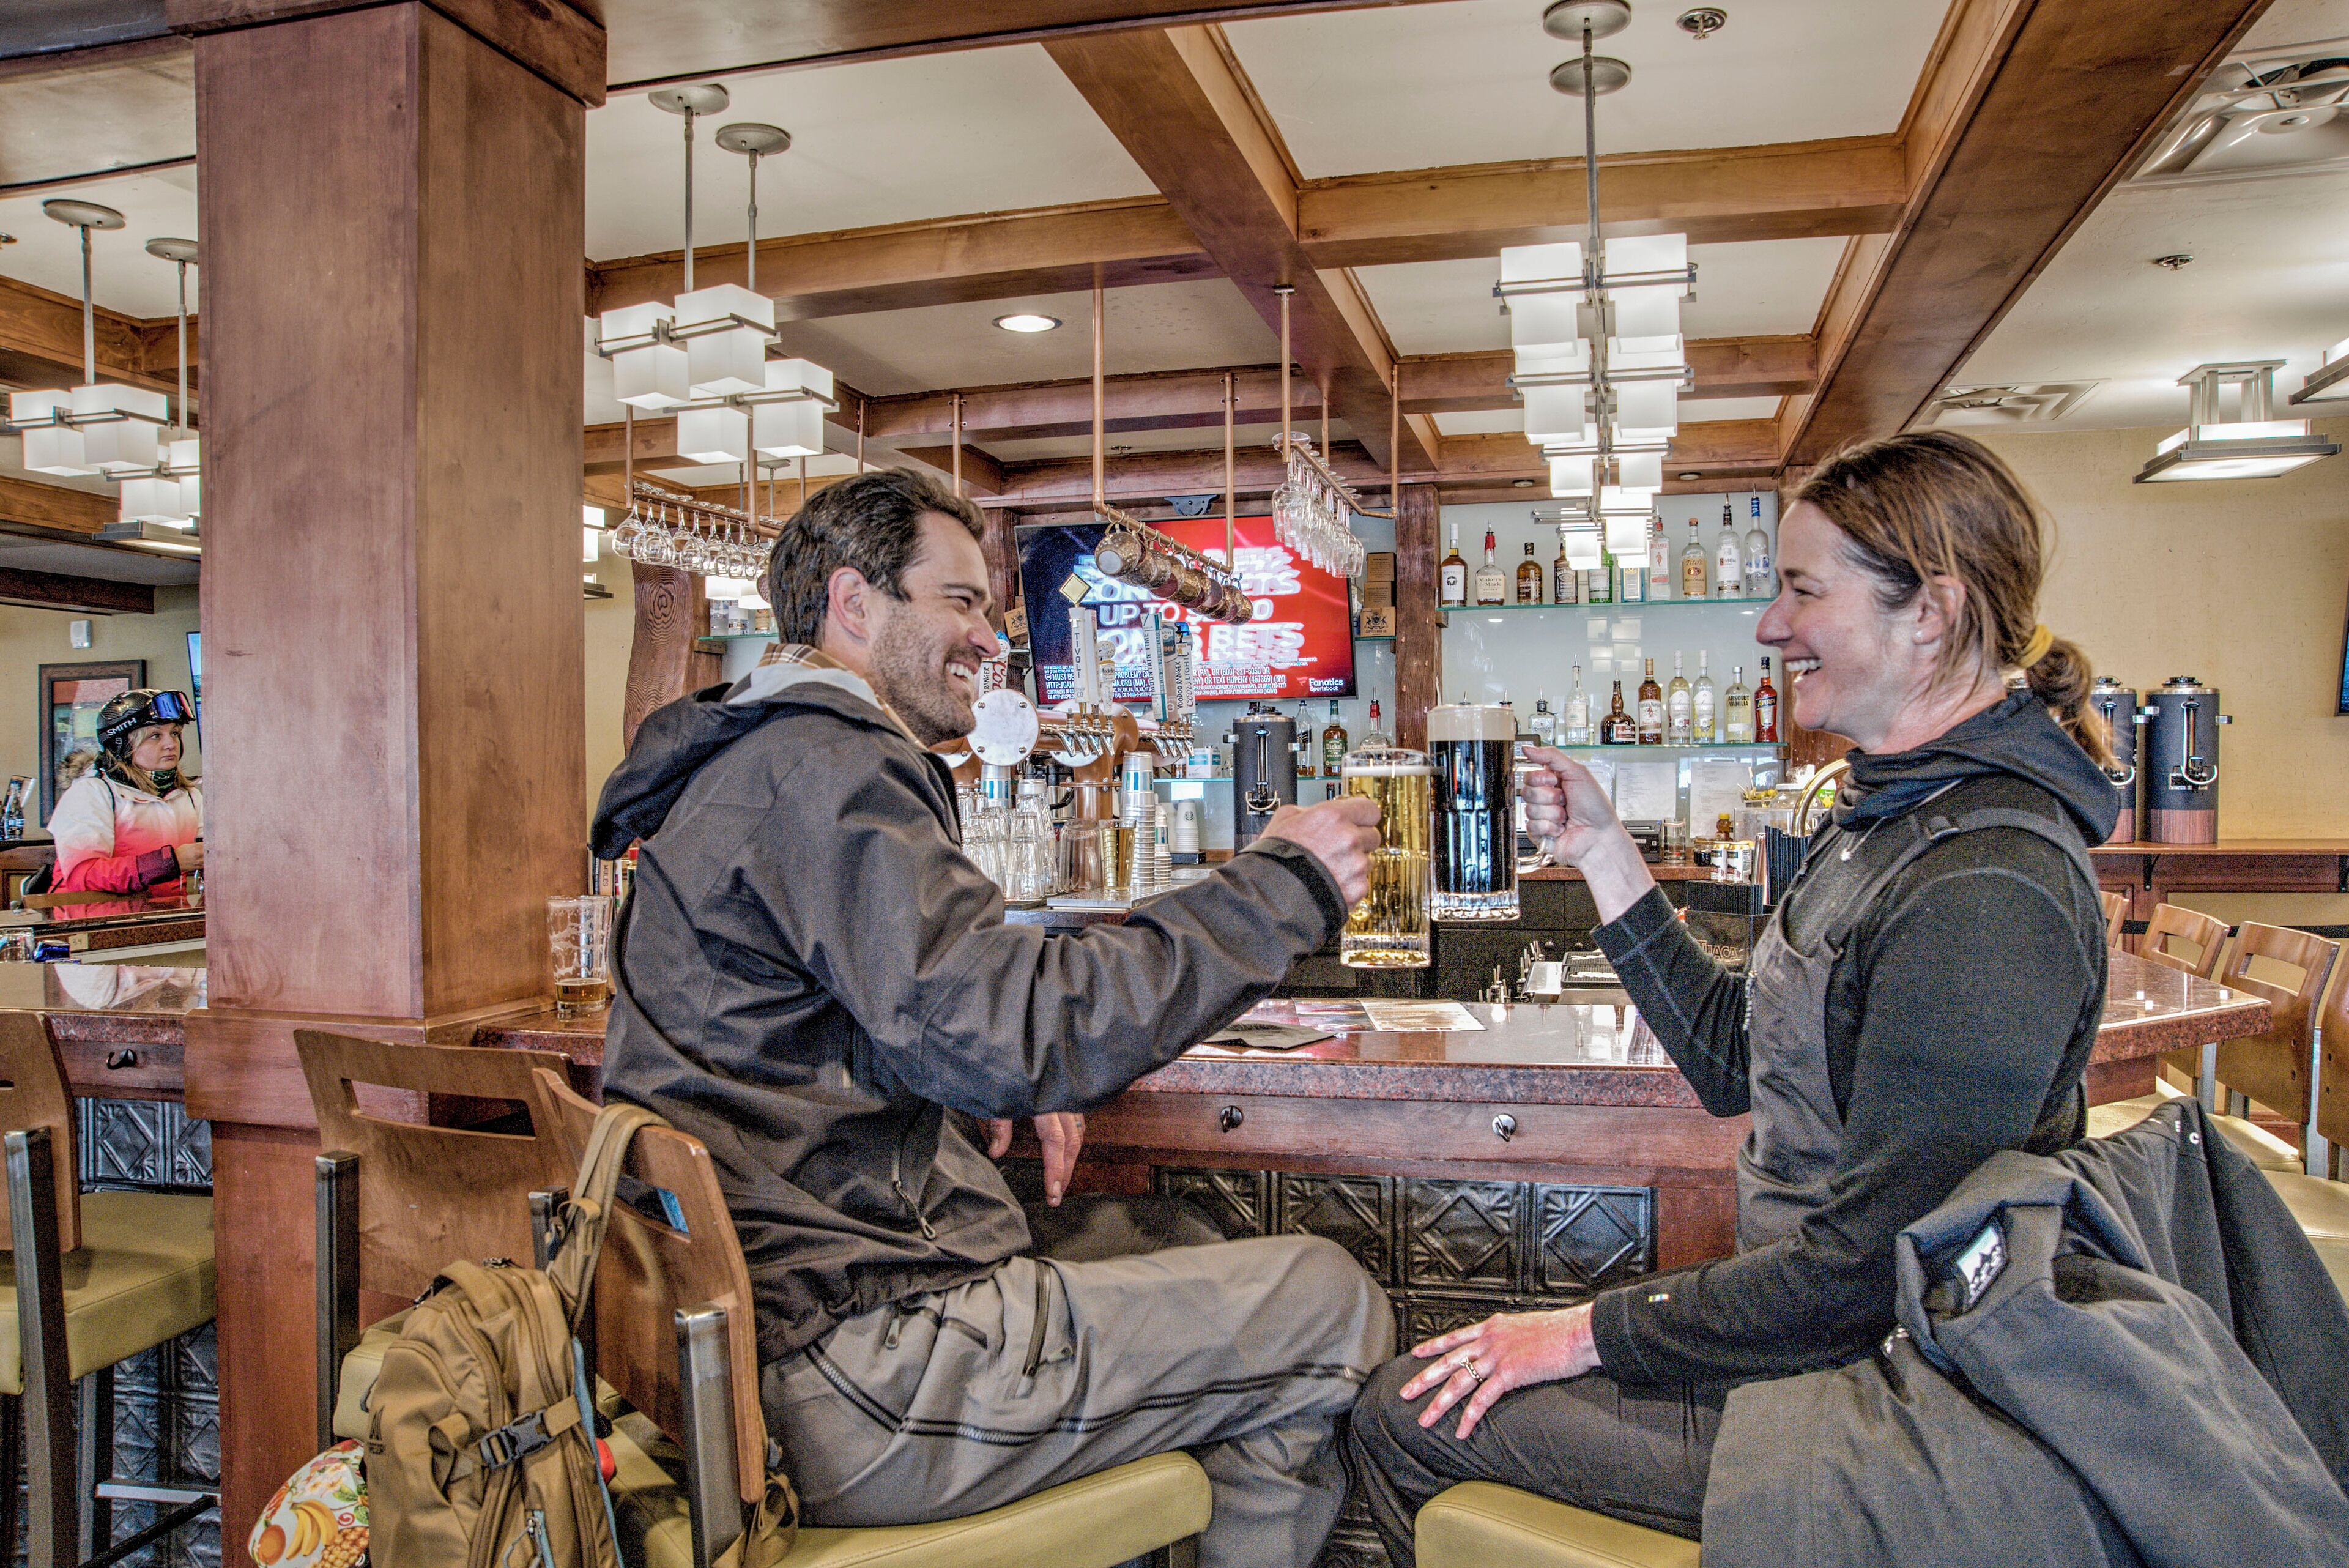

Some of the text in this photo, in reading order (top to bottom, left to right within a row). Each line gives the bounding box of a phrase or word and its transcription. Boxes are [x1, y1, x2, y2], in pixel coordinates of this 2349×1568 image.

[1099, 604, 1140, 626] UP
[1143, 602, 1181, 622] TO
[1209, 622, 1305, 651] BETS
[1146, 653, 1155, 693] MOUNTAIN
[1226, 675, 1248, 684] HOPENY
[1308, 678, 1343, 686] Fanatics
[1757, 698, 1776, 707] APEROL
[107, 717, 137, 736] SMITH
